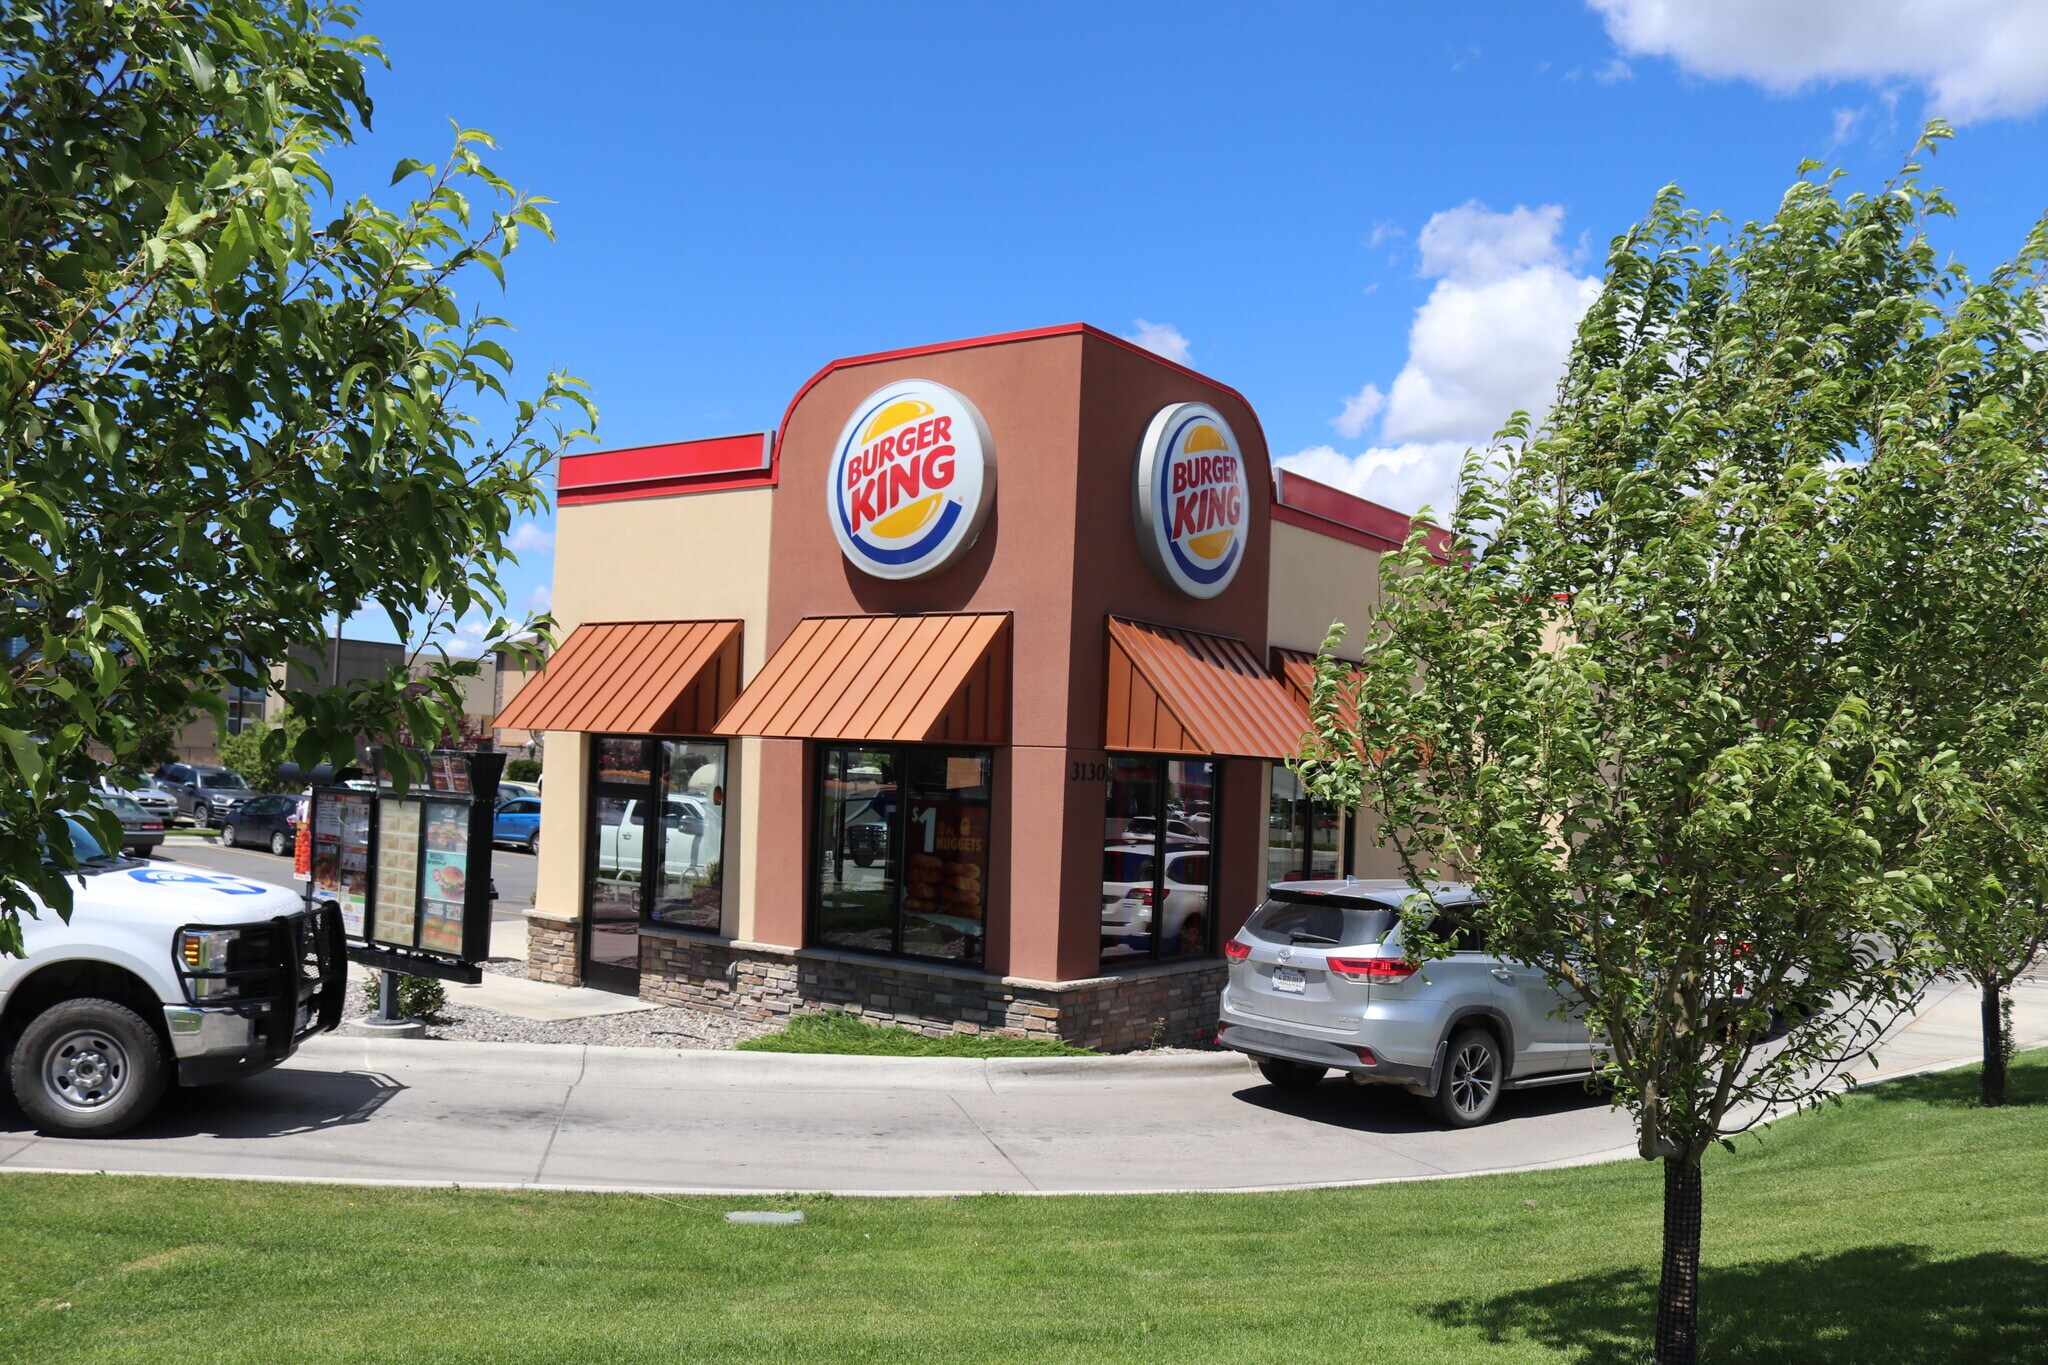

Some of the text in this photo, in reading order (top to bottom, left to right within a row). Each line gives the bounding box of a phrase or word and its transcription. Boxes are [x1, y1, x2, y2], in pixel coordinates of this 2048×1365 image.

[848, 415, 952, 491] BURGER
[1173, 455, 1239, 494] BURGER
[851, 445, 955, 534] KING
[1173, 486, 1241, 540] KING
[1071, 761, 1106, 782] 3130
[911, 806, 937, 853] $1
[936, 836, 982, 852] NUGGETS
